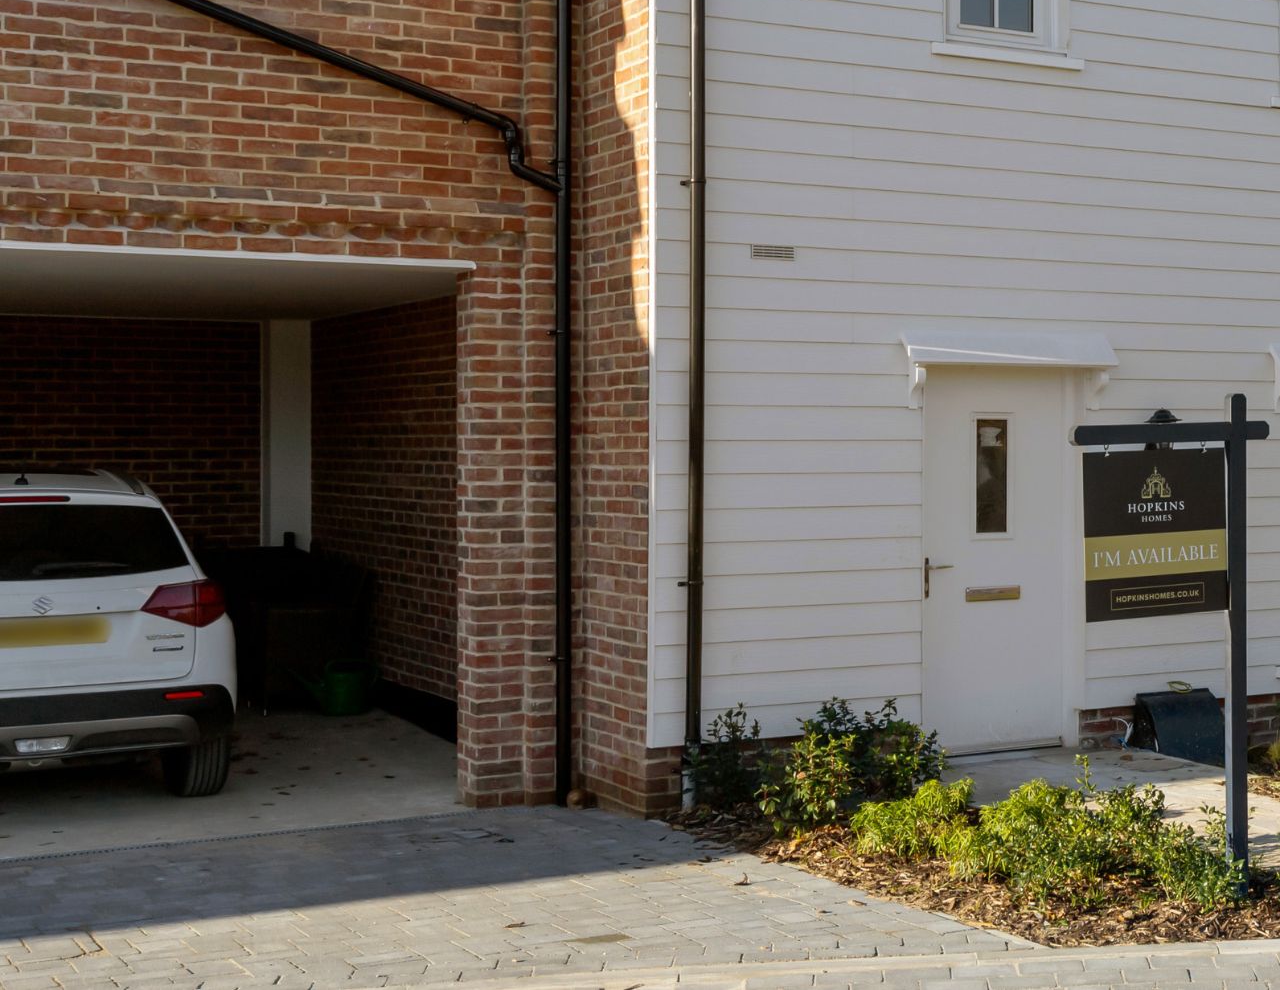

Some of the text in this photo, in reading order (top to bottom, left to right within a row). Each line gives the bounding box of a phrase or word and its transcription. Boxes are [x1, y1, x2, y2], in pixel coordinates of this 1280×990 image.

[1128, 501, 1185, 513] HOPKINS
[1141, 514, 1172, 522] HOMES
[1093, 544, 1218, 567] I'M AVAILABLE
[1116, 590, 1199, 602] HOPKINSHOMES.CO.UK
